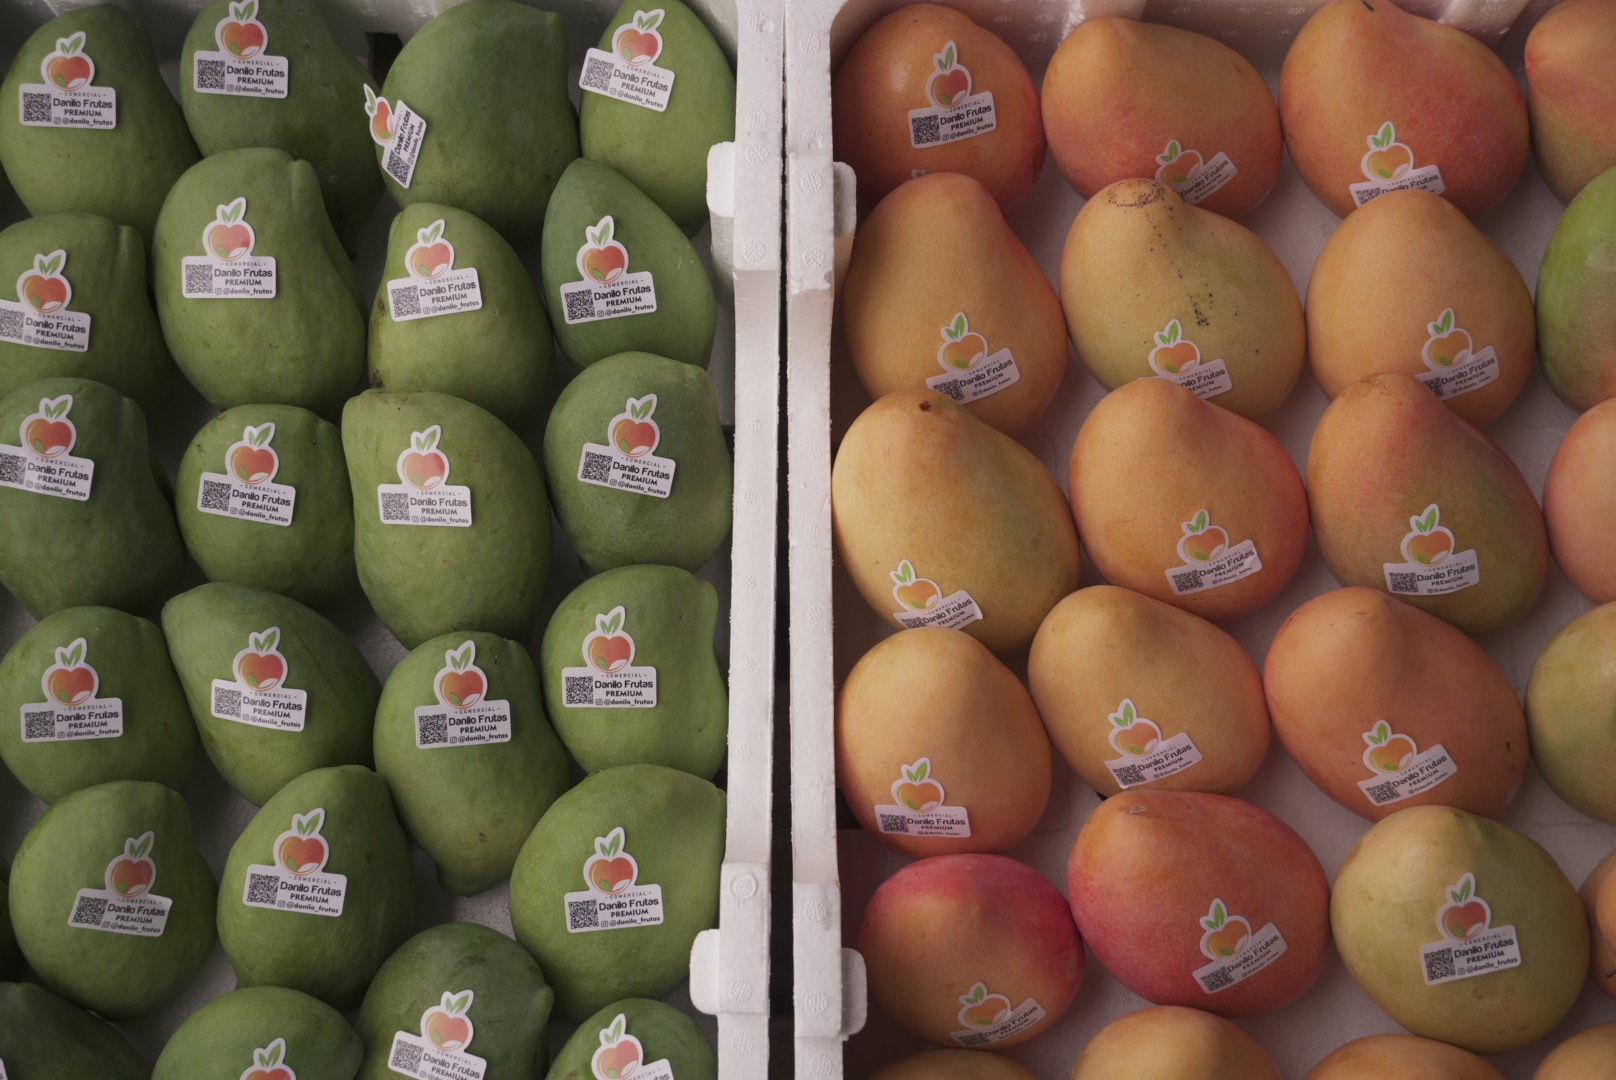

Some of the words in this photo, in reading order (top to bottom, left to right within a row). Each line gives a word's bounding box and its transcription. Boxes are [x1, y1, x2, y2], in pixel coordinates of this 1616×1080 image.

[226, 65, 254, 76] Danilo
[256, 67, 285, 78] Frutas
[237, 76, 274, 85] PREMIUM
[613, 69, 640, 83] Danilo
[641, 76, 668, 92] Frutas
[235, 85, 284, 95] @danilo_frutas
[621, 82, 656, 97] PREMIUM
[53, 98, 81, 107] Danilo
[83, 99, 113, 109] Frutas
[617, 90, 664, 108] @danilo_frutas
[62, 117, 113, 126] @danilo_frutas
[940, 113, 965, 126] Danilo
[966, 105, 992, 118] Frutas
[951, 116, 983, 131] PREMIUM
[950, 123, 994, 140] @danilo_frutas
[1410, 175, 1439, 188] Frutas
[214, 269, 242, 277] Danilo
[244, 268, 273, 277] Frutas
[223, 288, 273, 296] @danilo_frutas
[419, 286, 447, 297] Danilo
[448, 282, 476, 292] Frutas
[594, 290, 621, 301] Danilo
[622, 286, 651, 296] Frutas
[431, 293, 468, 304] PREMIUM
[606, 296, 642, 307] PREMIUM
[431, 301, 480, 313] @danilo_frutas
[605, 304, 654, 316] @danilo_frutas
[25, 318, 54, 329] Danilo
[56, 322, 86, 334] Frutas
[36, 329, 74, 340] PREMIUM
[32, 337, 84, 349] @danilo_frutas
[960, 373, 985, 387] Danilo
[987, 359, 1013, 376] Frutas
[1197, 369, 1225, 383] Frutas
[1441, 371, 1467, 384] Danilo
[1469, 358, 1495, 374] Frutas
[27, 462, 57, 475] Danilo
[58, 468, 89, 481] Frutas
[612, 461, 640, 474] Danilo
[641, 467, 670, 480] Frutas
[37, 474, 76, 487] PREMIUM
[621, 473, 657, 486] PREMIUM
[34, 483, 86, 497] @danilo_frutas
[618, 481, 666, 495] @danilo_frutas
[232, 489, 260, 501] Danilo
[262, 494, 291, 506] Frutas
[410, 497, 437, 506] Danilo
[439, 498, 468, 507] Frutas
[242, 501, 278, 513] PREMIUM
[238, 509, 288, 522] @danilo_frutas
[420, 516, 469, 524] @danilo_frutas
[1199, 564, 1226, 576] Danilo
[1227, 550, 1254, 566] Frutas
[1417, 572, 1445, 581] Danilo
[1447, 564, 1475, 577] Frutas
[923, 612, 946, 623] Danilo
[946, 599, 972, 615] Frutas
[594, 680, 622, 689] Danilo
[624, 680, 653, 688] Frutas
[243, 696, 271, 708] Danilo
[272, 700, 303, 711] Frutas
[56, 713, 86, 722] Danilo
[88, 711, 119, 720] Frutas
[253, 708, 290, 718] PREMIUM
[68, 721, 108, 729] PREMIUM
[250, 716, 301, 728] @danilo_frutas
[448, 716, 476, 726] Danilo
[478, 714, 507, 723] Frutas
[66, 729, 120, 738] @danilo_frutas
[460, 725, 497, 734] PREMIUM
[458, 734, 508, 743] @danilo_frutas
[1138, 758, 1164, 771] Danilo
[1164, 744, 1192, 761] Frutas
[1393, 773, 1419, 787] Danilo
[1419, 756, 1447, 774] Frutas
[280, 881, 309, 893] Danilo
[311, 885, 342, 897] Frutas
[290, 893, 328, 904] PREMIUM
[598, 901, 627, 911] Danilo
[629, 898, 659, 908] Frutas
[107, 904, 136, 914] Danilo
[137, 906, 166, 917] Frutas
[286, 901, 339, 913] @danilo_frutas
[611, 908, 649, 918] PREMIUM
[115, 914, 152, 924] PREMIUM
[609, 917, 660, 926] @danilo_frutas
[111, 923, 160, 933] @danilo_frutas
[1227, 954, 1253, 972] Danilo
[1254, 935, 1279, 956] Frutas
[1454, 946, 1482, 958] Danilo
[1484, 938, 1514, 951] Frutas
[1466, 950, 1505, 964] PREMIUM
[1466, 957, 1518, 973] @danilo_frutas
[424, 1053, 450, 1068] Danilo
[452, 1063, 480, 1078] Frutas
